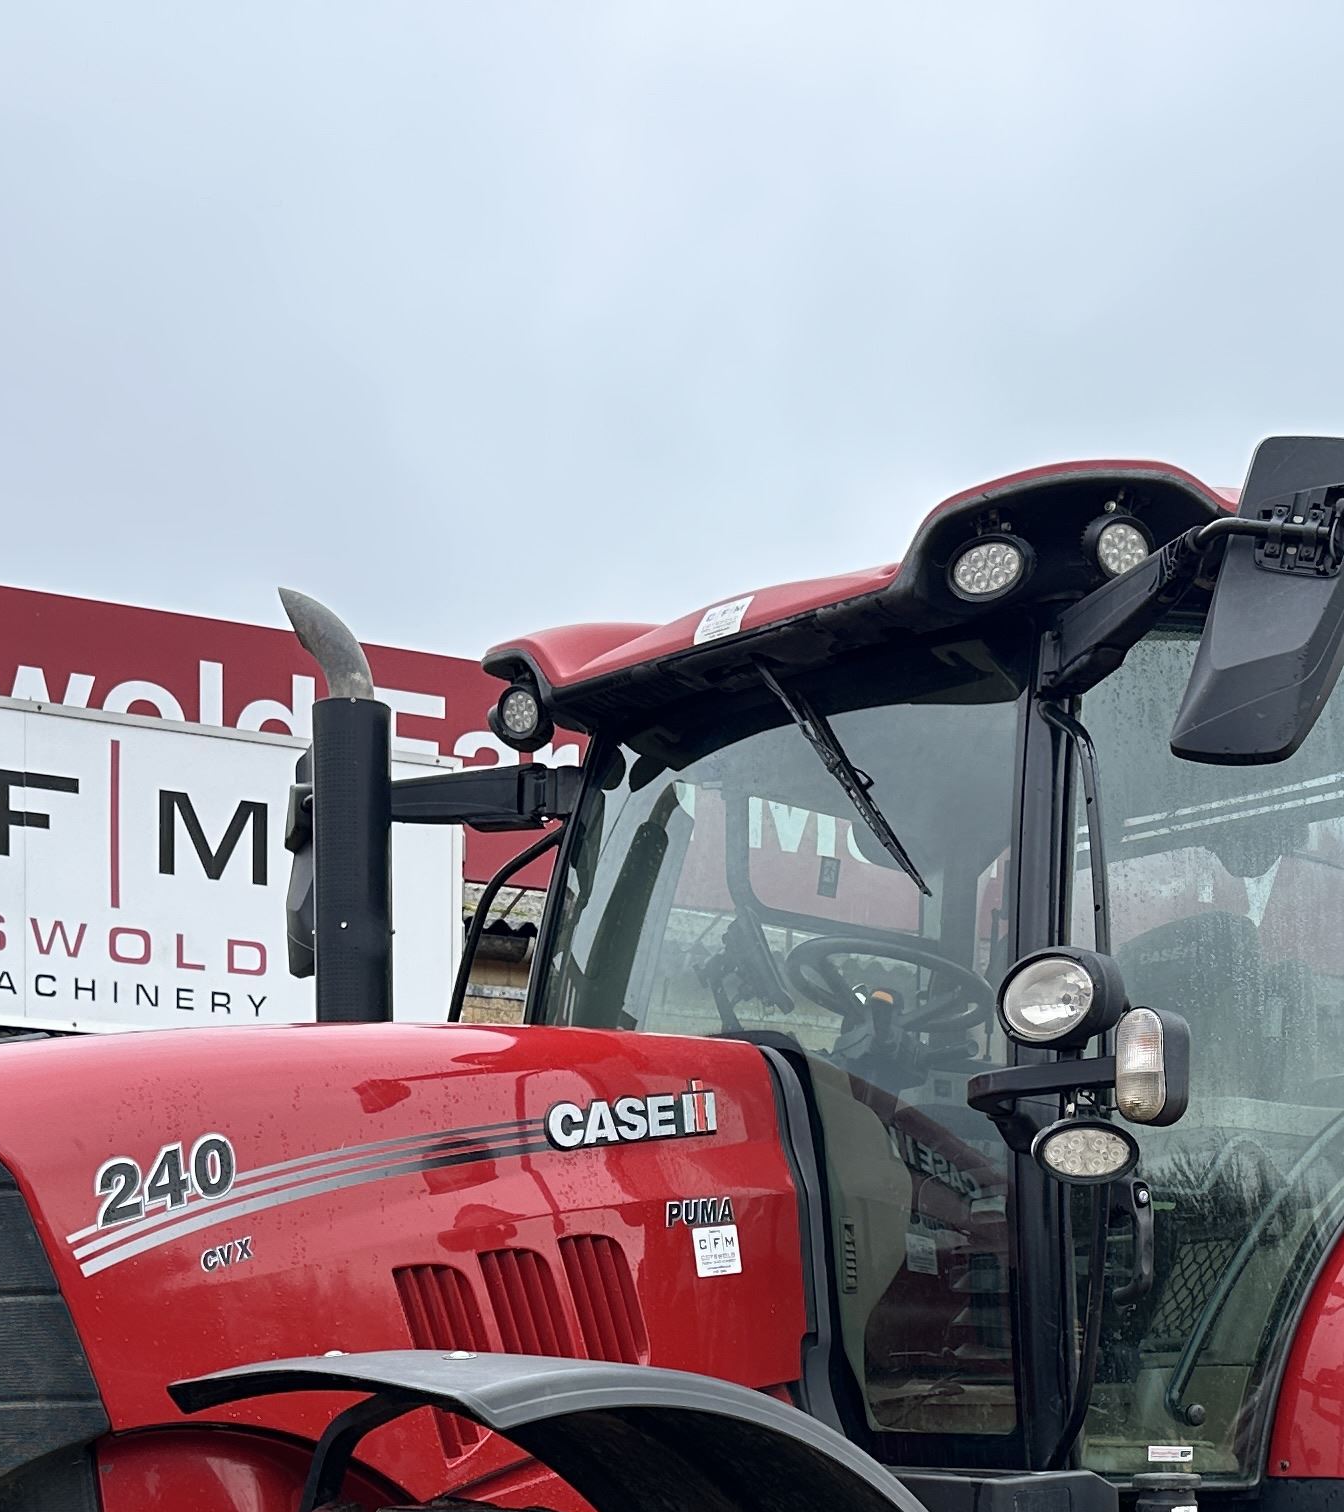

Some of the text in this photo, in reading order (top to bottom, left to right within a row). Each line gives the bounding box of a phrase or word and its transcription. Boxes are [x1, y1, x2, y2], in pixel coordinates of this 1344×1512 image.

[158, 788, 268, 886] M
[547, 1095, 676, 1149] CASE
[94, 1132, 236, 1230] 240
[666, 1196, 736, 1228] PUMA
[200, 1235, 255, 1273] CVX
